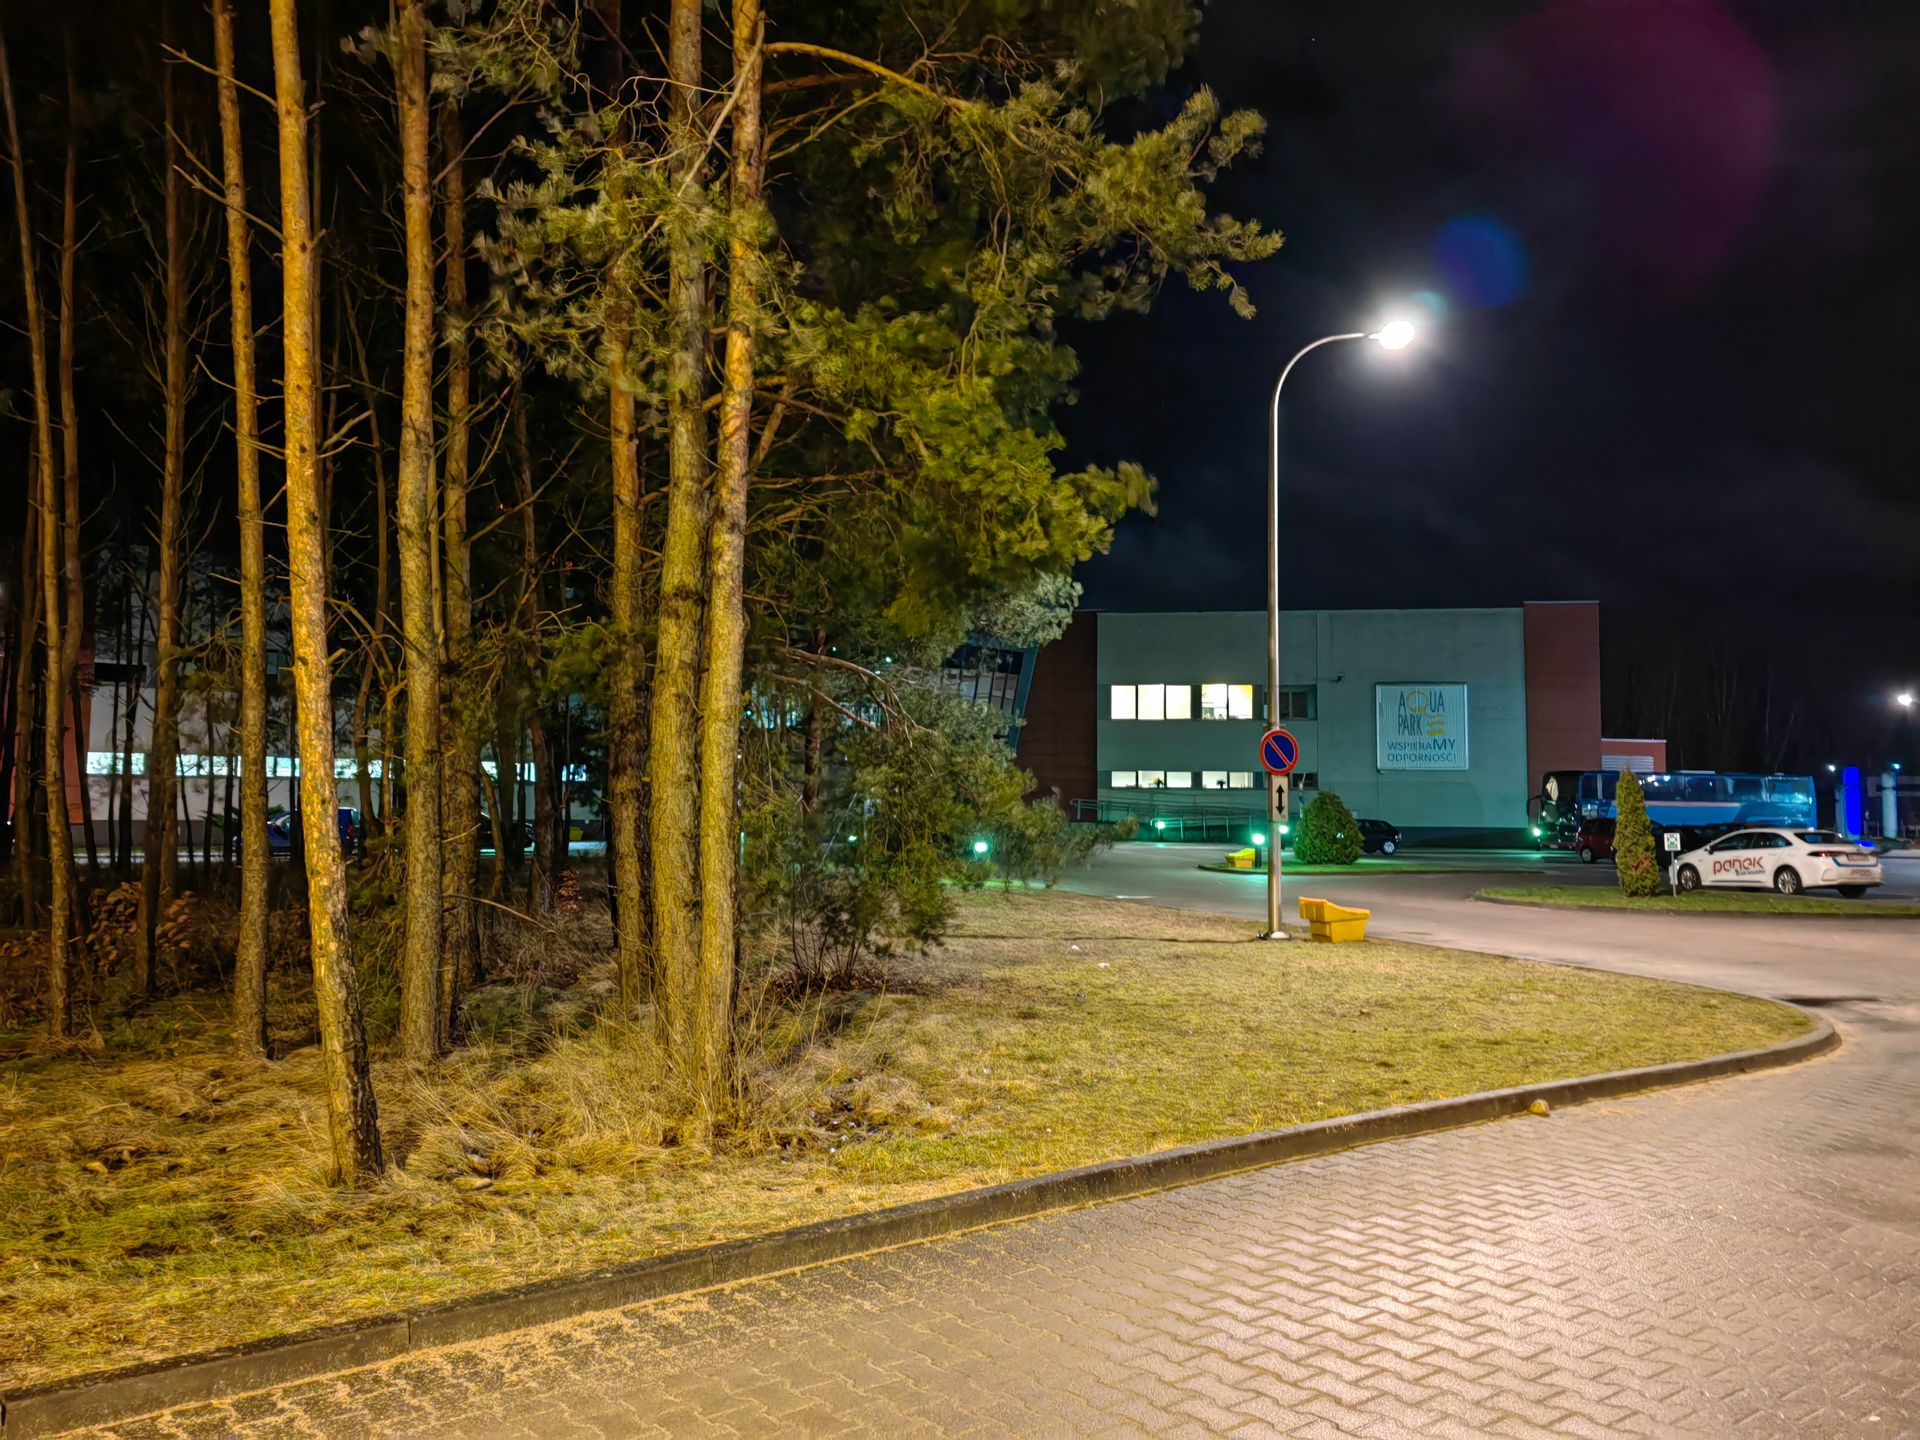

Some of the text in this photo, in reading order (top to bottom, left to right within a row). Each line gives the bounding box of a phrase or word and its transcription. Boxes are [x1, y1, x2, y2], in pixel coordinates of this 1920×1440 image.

[1398, 690, 1445, 717] AQUA
[1398, 713, 1423, 736] PARK
[1713, 856, 1764, 875] panek
